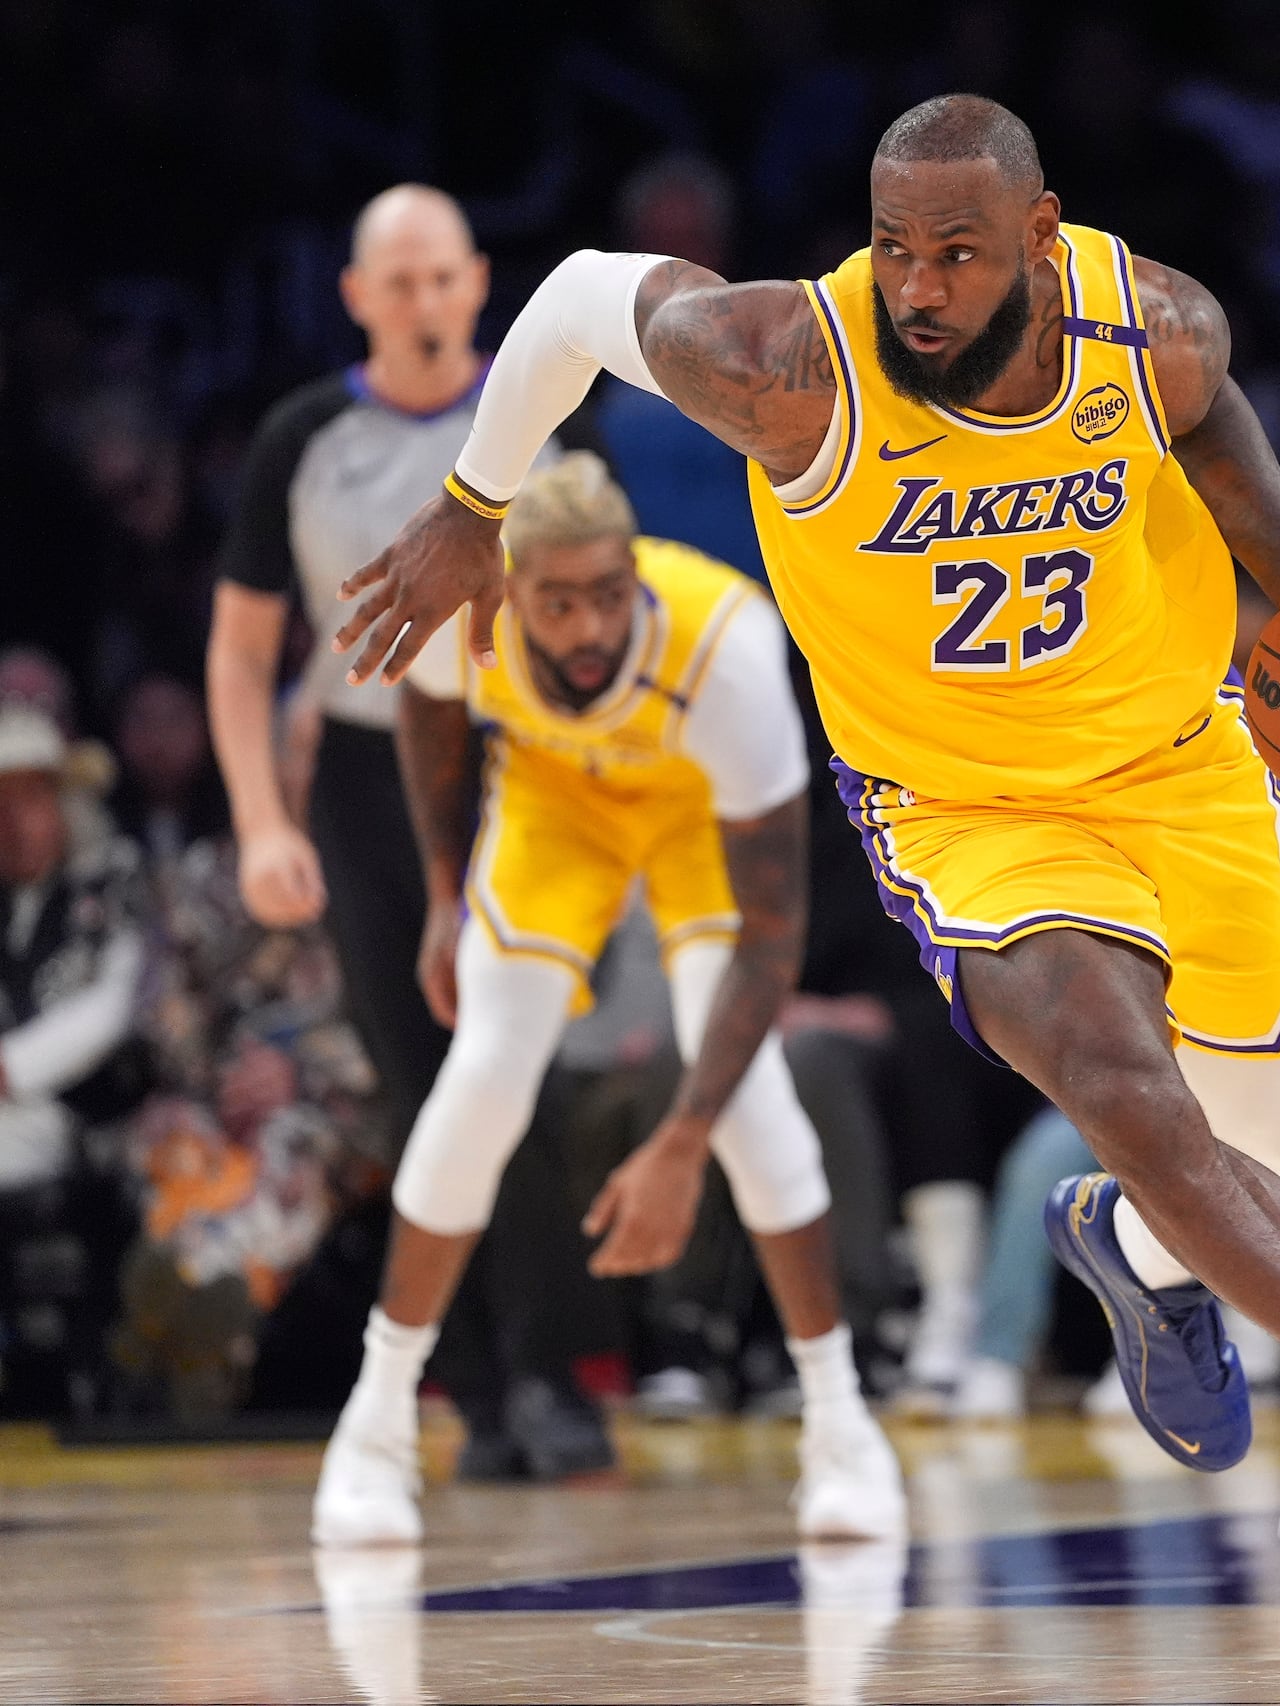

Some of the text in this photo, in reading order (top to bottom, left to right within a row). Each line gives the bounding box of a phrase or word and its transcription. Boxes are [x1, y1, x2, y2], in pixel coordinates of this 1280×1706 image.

[1094, 324, 1114, 341] 44
[1075, 397, 1125, 428] bibigo
[1085, 417, 1108, 432] 비비고
[855, 458, 1131, 555] LAKERS
[930, 547, 1095, 672] 23
